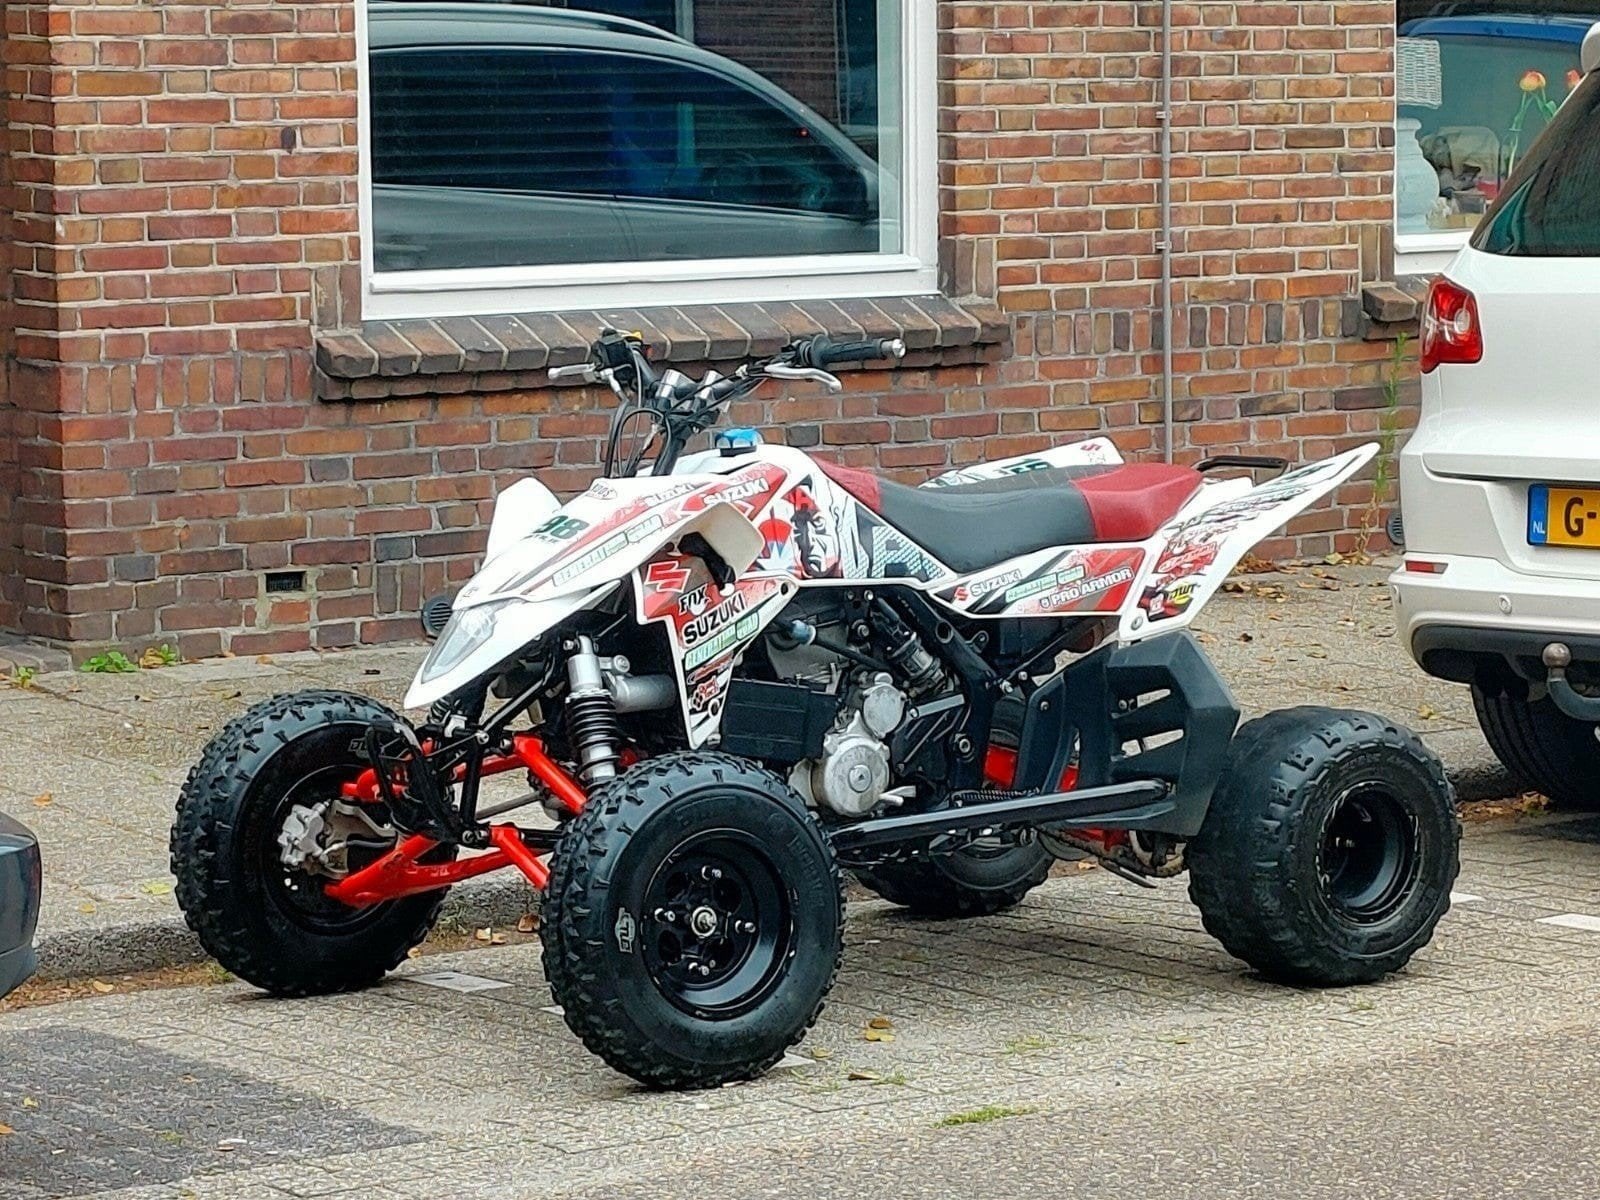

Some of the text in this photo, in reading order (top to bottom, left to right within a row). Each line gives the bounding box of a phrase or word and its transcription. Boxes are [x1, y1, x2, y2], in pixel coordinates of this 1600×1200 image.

[703, 477, 770, 506] SUZUKI
[1532, 520, 1546, 534] NL
[679, 583, 709, 614] FOX
[970, 569, 1023, 598] SUZUKI
[1051, 587, 1081, 608] PRO
[1080, 568, 1134, 598] ARMOR
[683, 592, 746, 645] SUZUKI
